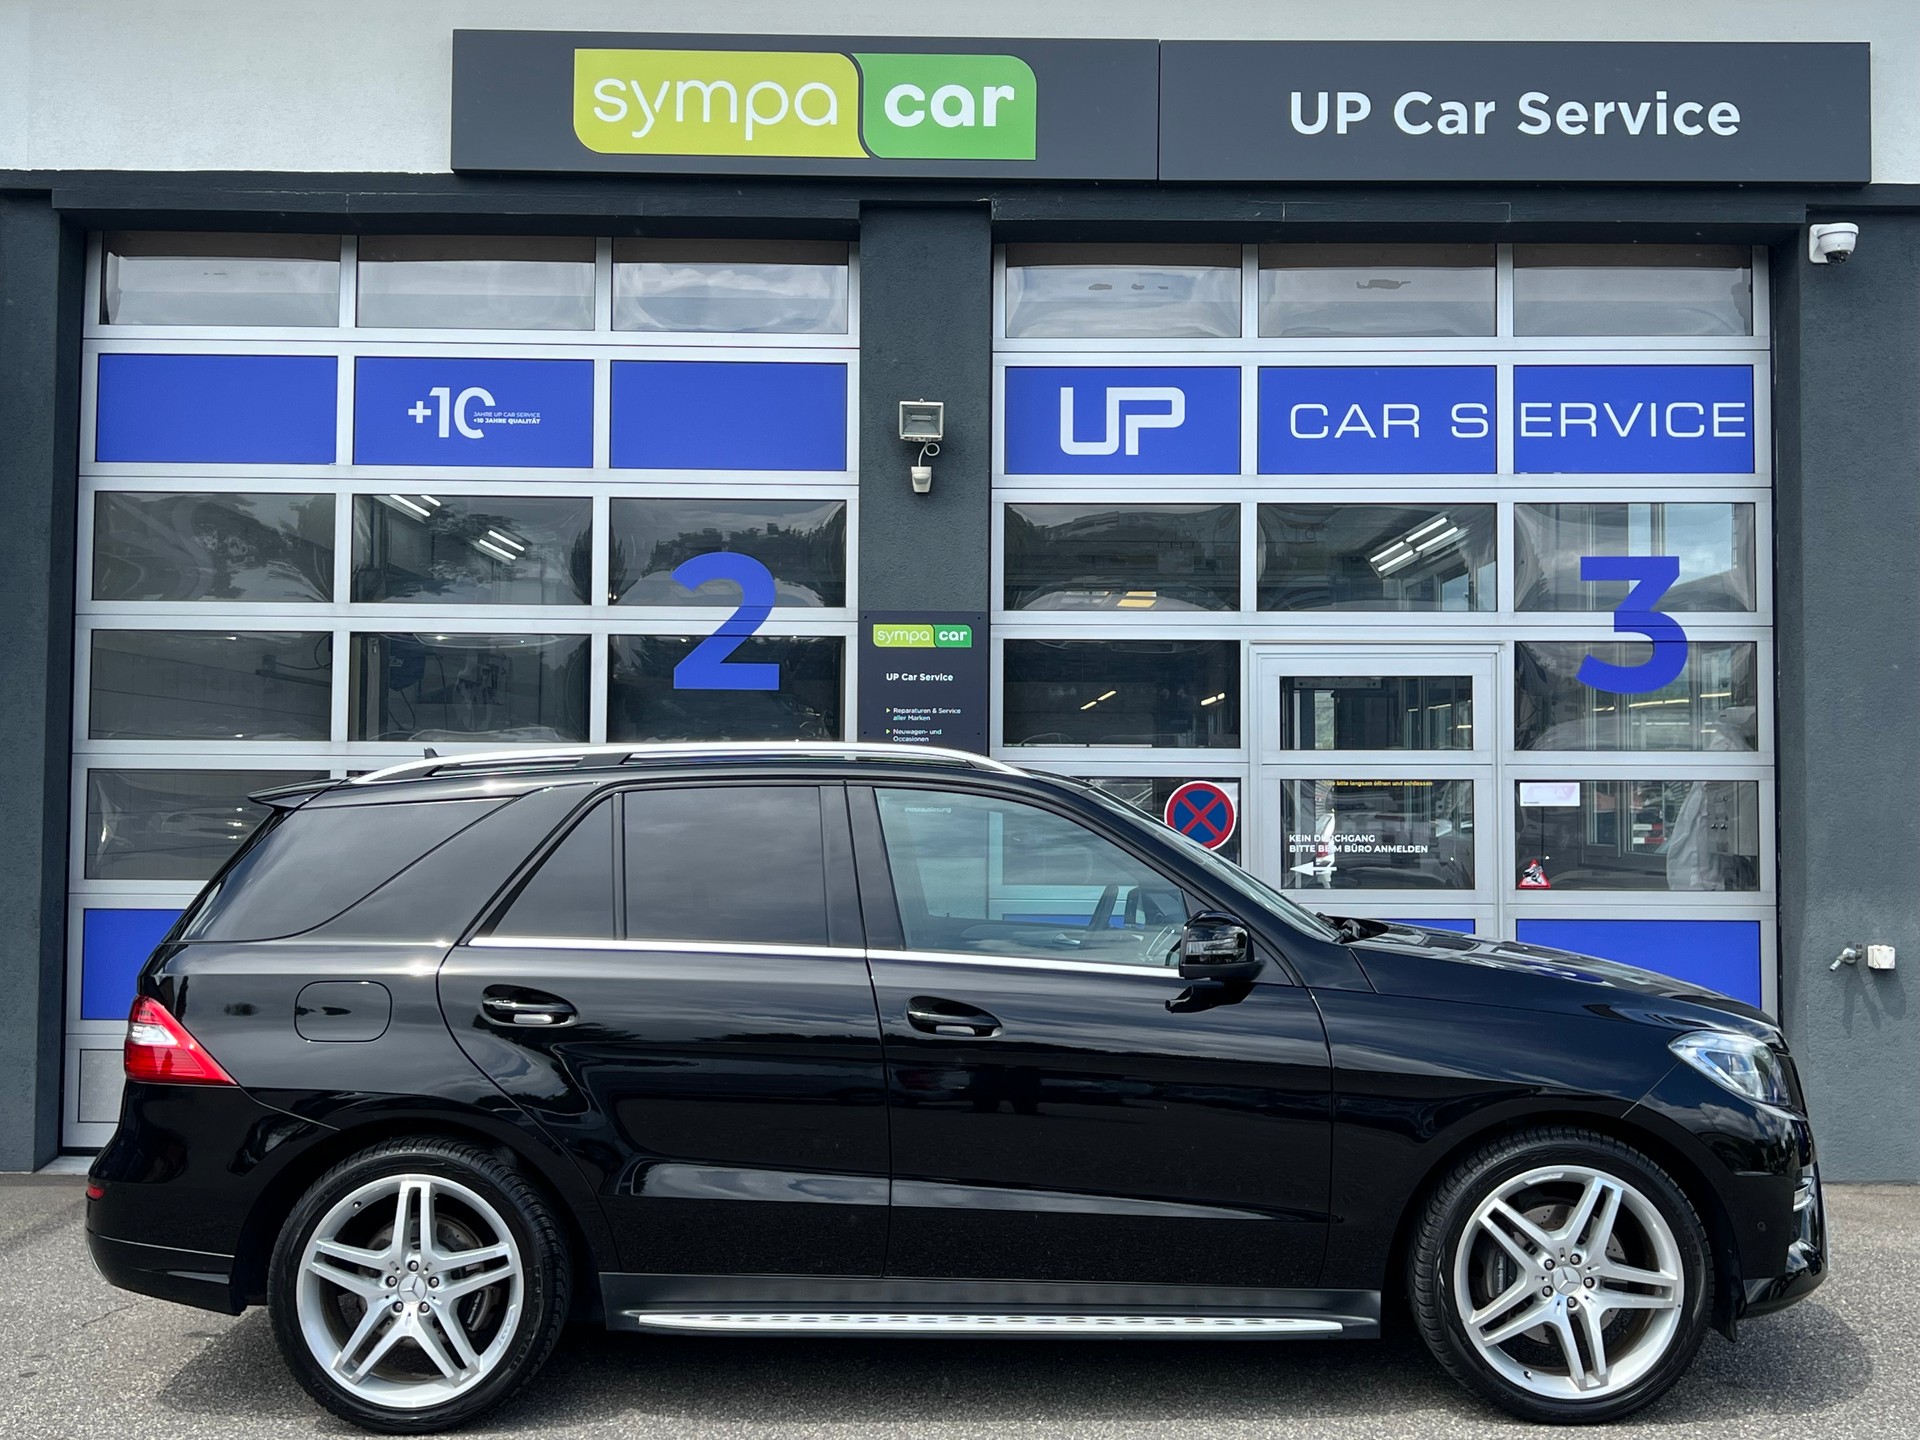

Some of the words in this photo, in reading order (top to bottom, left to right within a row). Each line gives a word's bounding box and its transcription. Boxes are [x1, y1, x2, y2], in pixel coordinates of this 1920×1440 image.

[592, 77, 838, 142] sympa
[884, 83, 1015, 128] car
[1291, 91, 1371, 135] UP
[1393, 91, 1496, 136] Car
[1517, 91, 1741, 136] Service
[508, 417, 541, 425] QUALITÄT
[1060, 387, 1185, 456] UP
[1290, 403, 1420, 439] CAR
[672, 551, 780, 690] 2
[1576, 556, 1688, 694] 3
[877, 630, 930, 644] sympa
[939, 630, 967, 641] car
[886, 673, 899, 681] UP
[901, 673, 917, 681] Car
[920, 673, 954, 682] Service
[893, 707, 931, 715] Reparaturen
[893, 728, 928, 736] Neuwagen-
[1289, 834, 1311, 843] KEIN
[1289, 845, 1316, 853] BITTE
[1317, 845, 1342, 853] BEM
[1344, 843, 1372, 853] BÜRO
[1373, 845, 1428, 853] ANMELDEN
